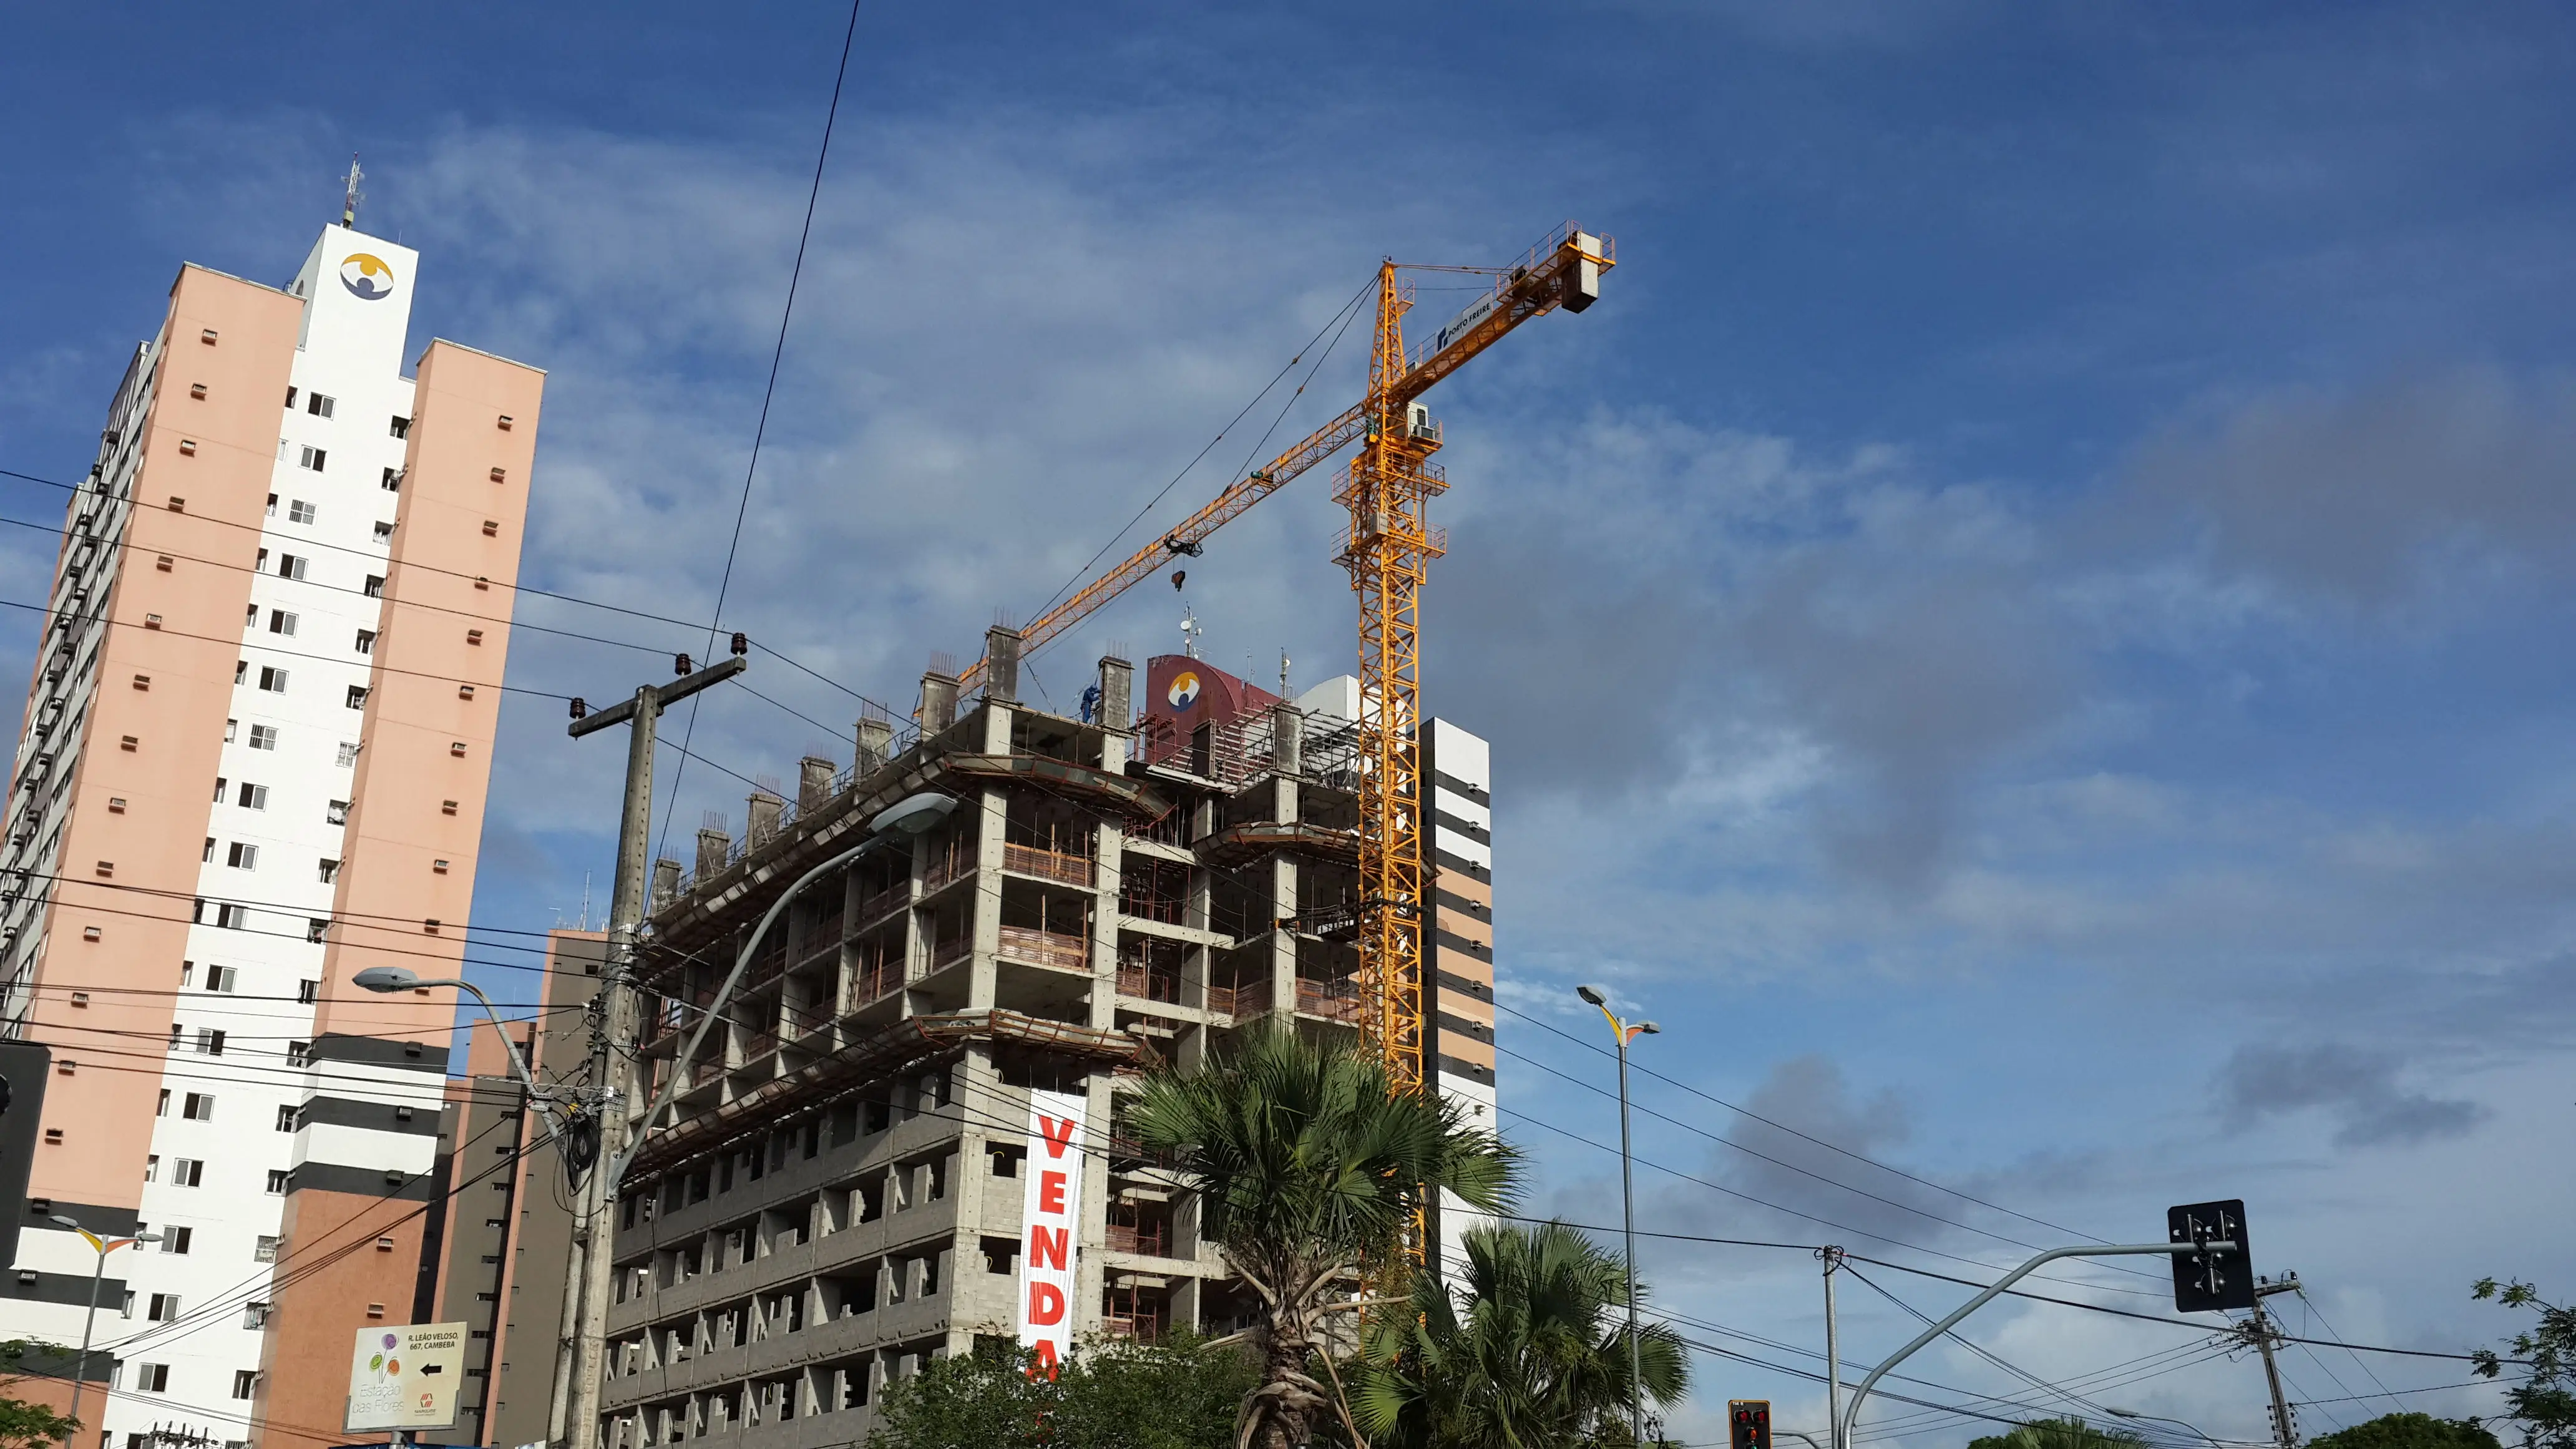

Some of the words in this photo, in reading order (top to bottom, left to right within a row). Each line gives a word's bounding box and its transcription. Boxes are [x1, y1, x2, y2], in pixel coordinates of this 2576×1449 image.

[1448, 319, 1468, 338] PORTO
[1469, 302, 1490, 322] FREIRE
[1025, 1115, 1076, 1383] VENDA
[415, 1332, 432, 1341] LEÃO
[432, 1332, 459, 1340] VELOSO,
[424, 1340, 455, 1349] CAMBEBA
[360, 1383, 401, 1398] Estação
